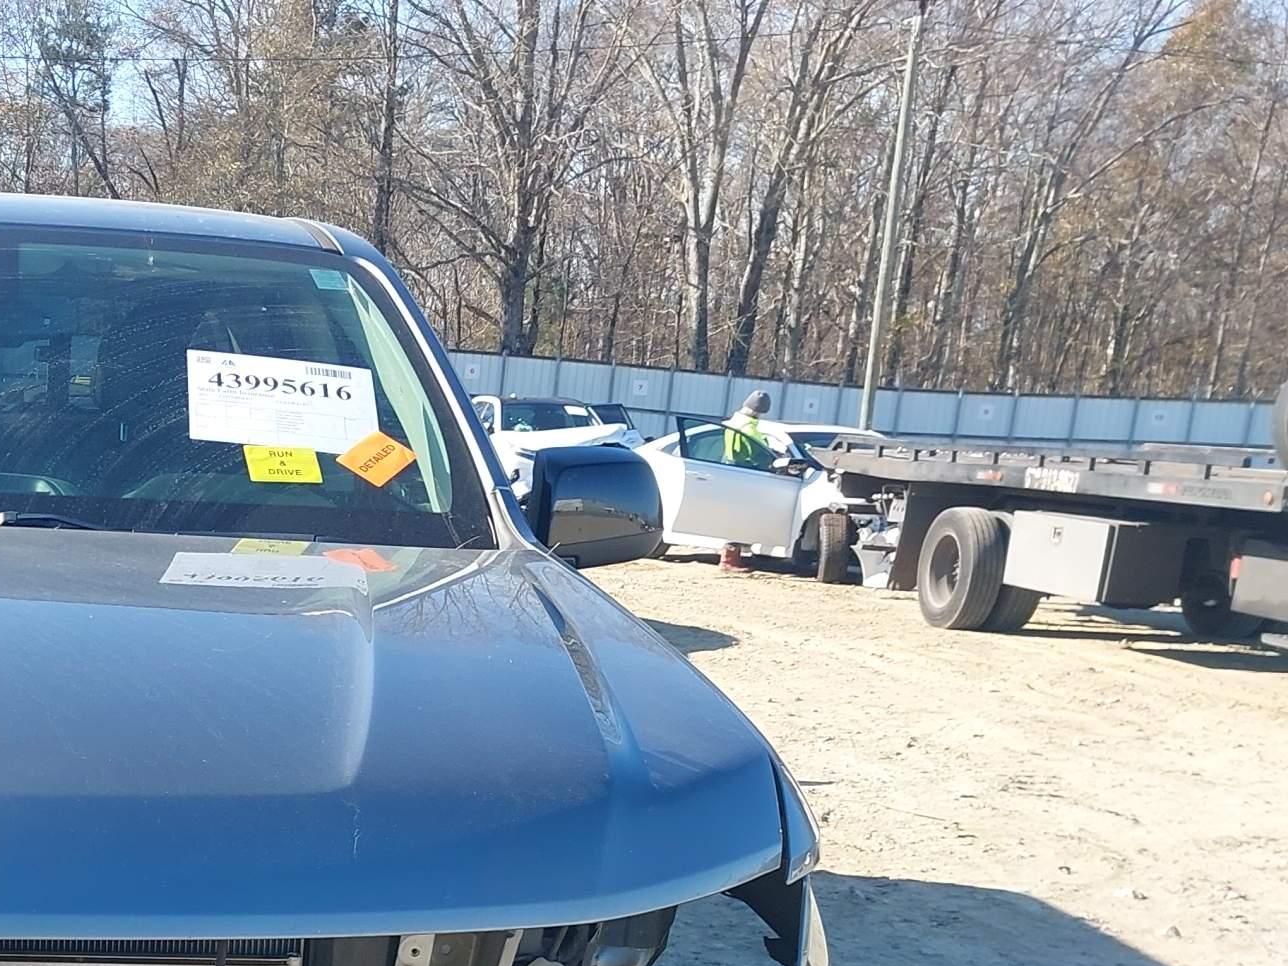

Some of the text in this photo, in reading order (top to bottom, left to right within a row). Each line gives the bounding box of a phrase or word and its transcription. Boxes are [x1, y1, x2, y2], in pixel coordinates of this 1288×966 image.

[208, 372, 352, 401] 43995616
[269, 450, 293, 458] RUN
[359, 444, 396, 473] DETAILED
[268, 468, 303, 476] DRIVE
